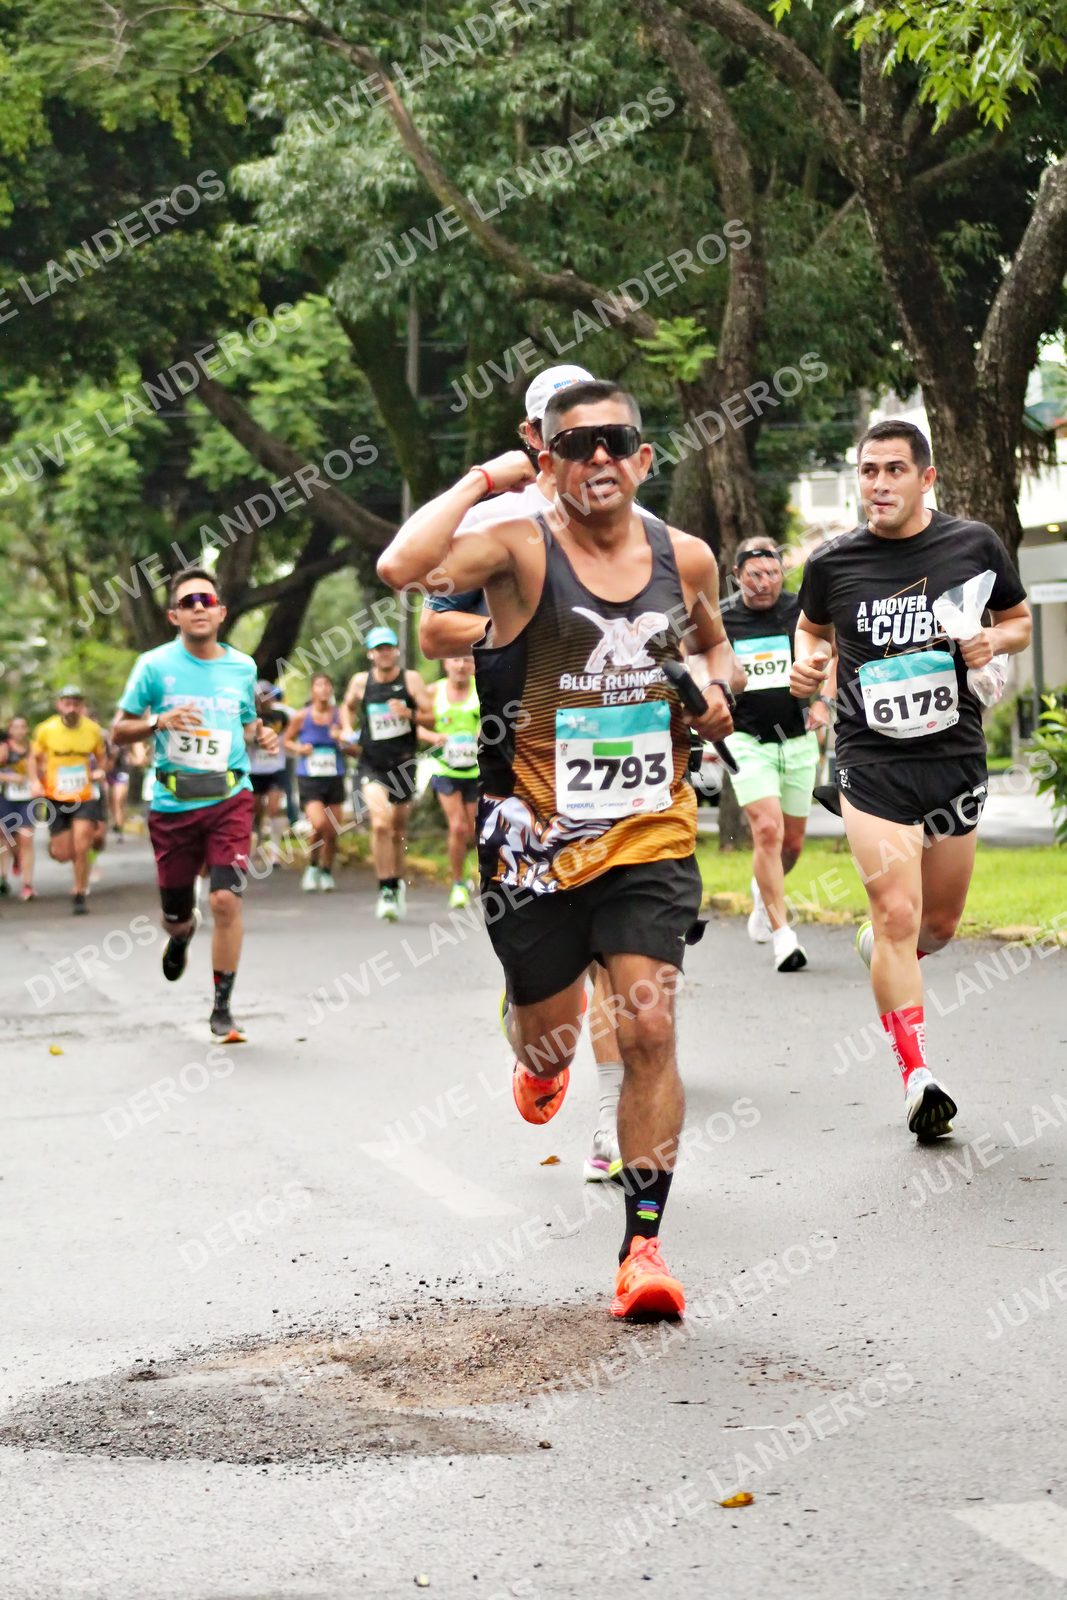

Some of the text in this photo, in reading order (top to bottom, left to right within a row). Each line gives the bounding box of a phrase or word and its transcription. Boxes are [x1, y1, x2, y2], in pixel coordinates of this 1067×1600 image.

[857, 595, 927, 617] A MOVER
[857, 618, 871, 632] EL
[743, 660, 787, 677] 3697
[560, 673, 602, 690] BLUE
[602, 688, 646, 705] TEAM
[873, 686, 953, 724] 6178
[179, 736, 219, 755] 315
[566, 752, 667, 791] 2793
